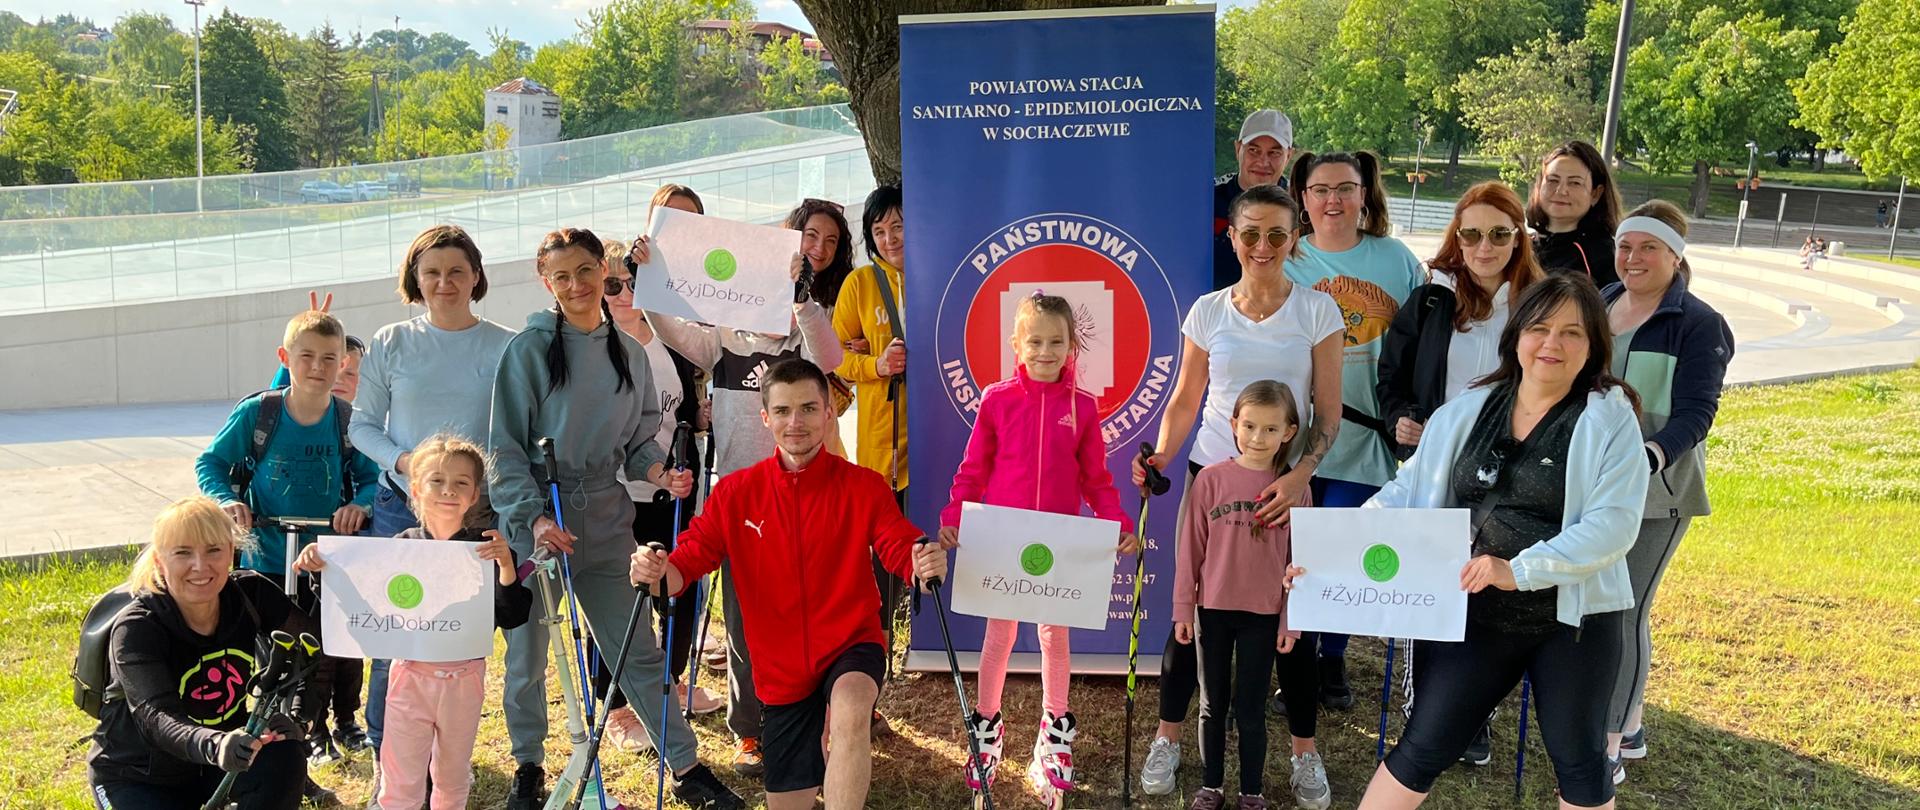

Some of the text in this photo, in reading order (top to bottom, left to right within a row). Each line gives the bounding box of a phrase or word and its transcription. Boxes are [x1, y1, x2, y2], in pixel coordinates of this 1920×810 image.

[969, 76, 1143, 95] POWIATOWA STACJA
[912, 104, 1010, 119] SANITARNO
[1024, 97, 1202, 117] EPIDEMIOLOGICZNA
[983, 122, 1130, 140] W SOCHACZEWIE
[971, 220, 1139, 275] PAŃSTWOWA
[666, 277, 766, 306] #ŻyjDobrze
[982, 574, 1082, 600] #ŻyjDobrze
[1321, 584, 1436, 607] #ŻyjDobrze
[349, 611, 462, 632] #ŻyjDobrze
